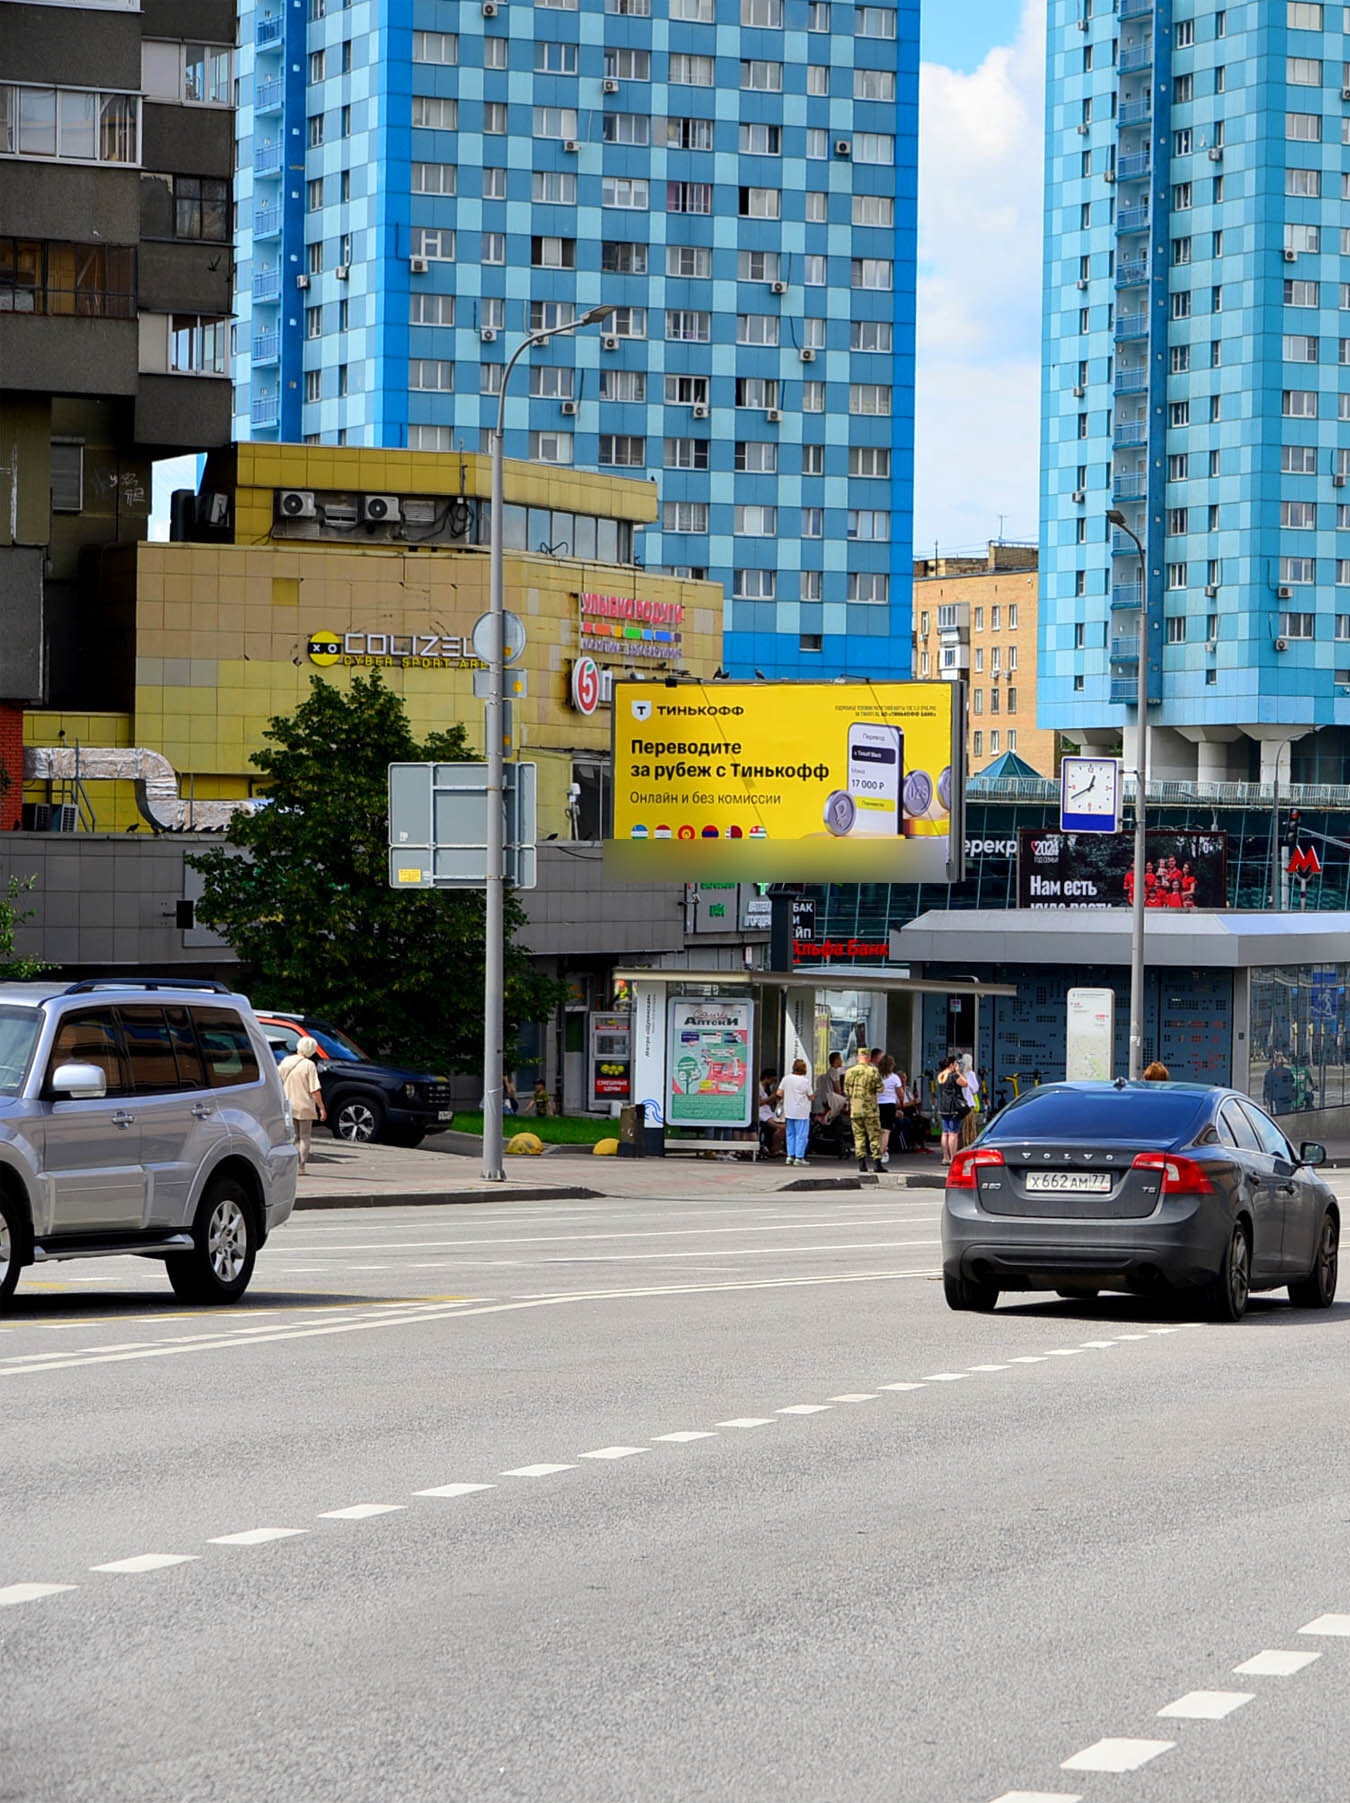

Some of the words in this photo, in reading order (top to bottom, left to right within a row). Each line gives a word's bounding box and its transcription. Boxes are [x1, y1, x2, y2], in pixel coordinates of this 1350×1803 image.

[344, 657, 392, 667] CYBER
[402, 659, 449, 668] SPORT
[657, 706, 744, 716] ТИНЬКОФФ
[631, 740, 742, 757] Переводите
[631, 765, 650, 777] за
[655, 762, 711, 781] рубеж
[716, 766, 726, 777] с
[731, 763, 829, 781] Тинькофф
[630, 791, 678, 804] Онлайн
[681, 794, 689, 803] и
[692, 791, 714, 804] без
[718, 795, 781, 805] комиссии
[1030, 876, 1060, 896] Нам
[1064, 879, 1098, 896] есть
[847, 939, 889, 956] Банк
[1022, 1152, 1113, 1160] VOLVO
